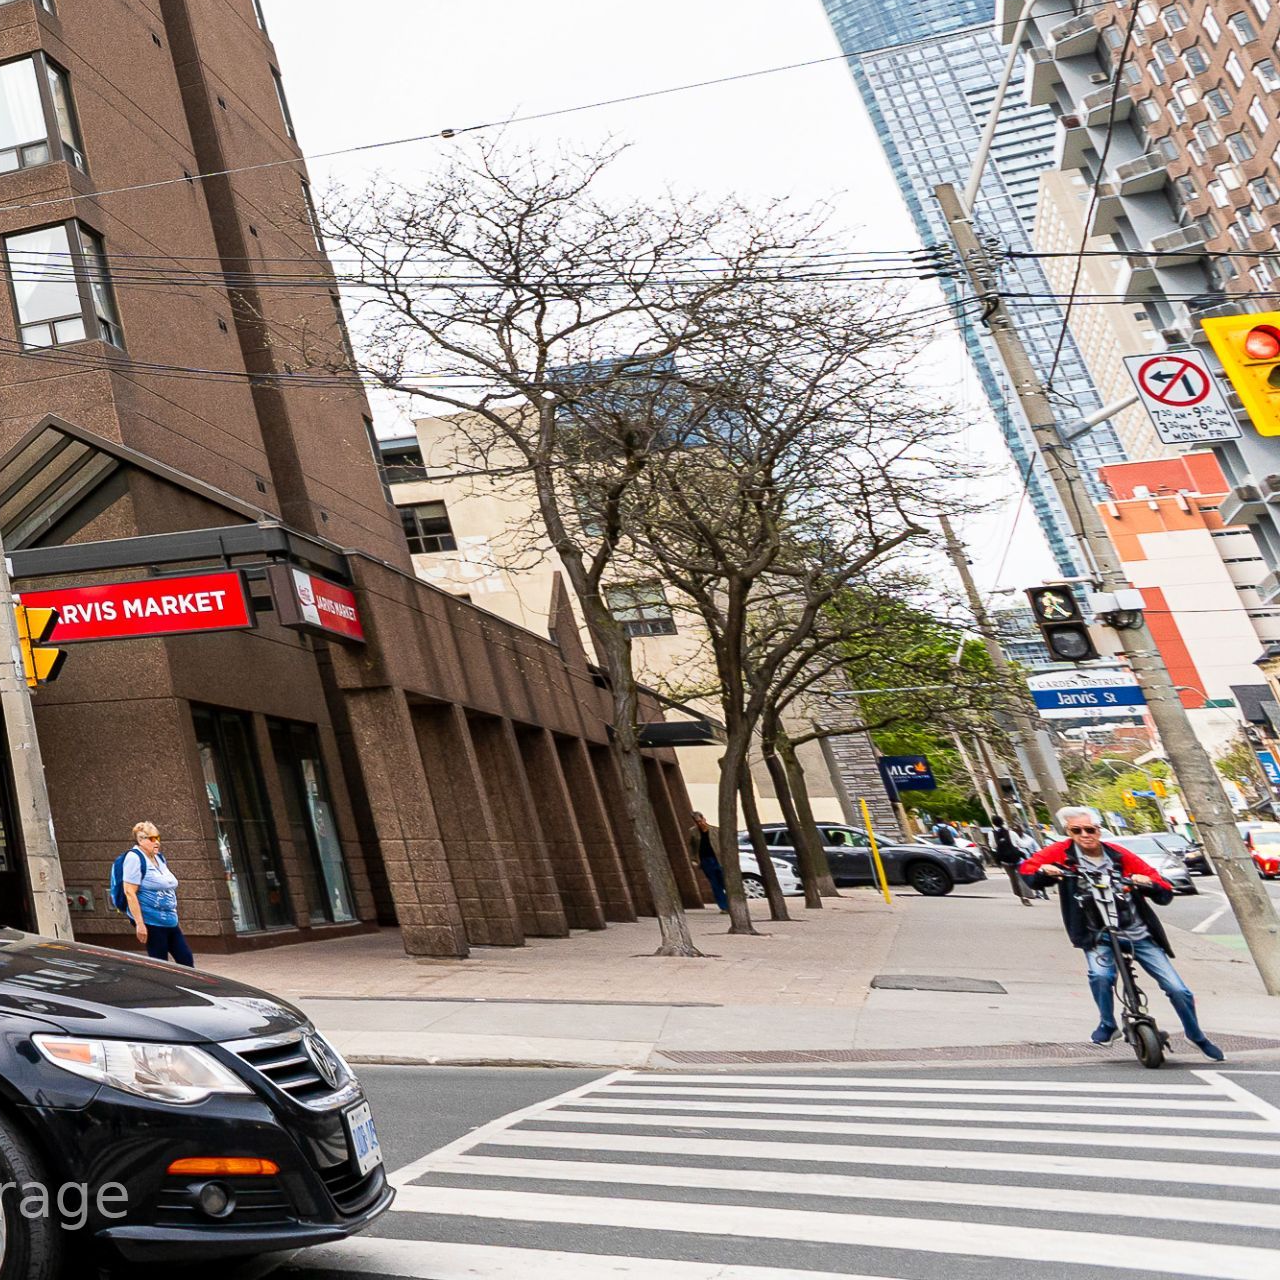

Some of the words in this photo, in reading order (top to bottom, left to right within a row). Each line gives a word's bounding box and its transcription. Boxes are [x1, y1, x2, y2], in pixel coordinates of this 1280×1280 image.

[57, 600, 118, 625] RVIS
[122, 589, 226, 619] MARKET
[1057, 690, 1099, 705] Jarvis
[1102, 691, 1119, 703] St
